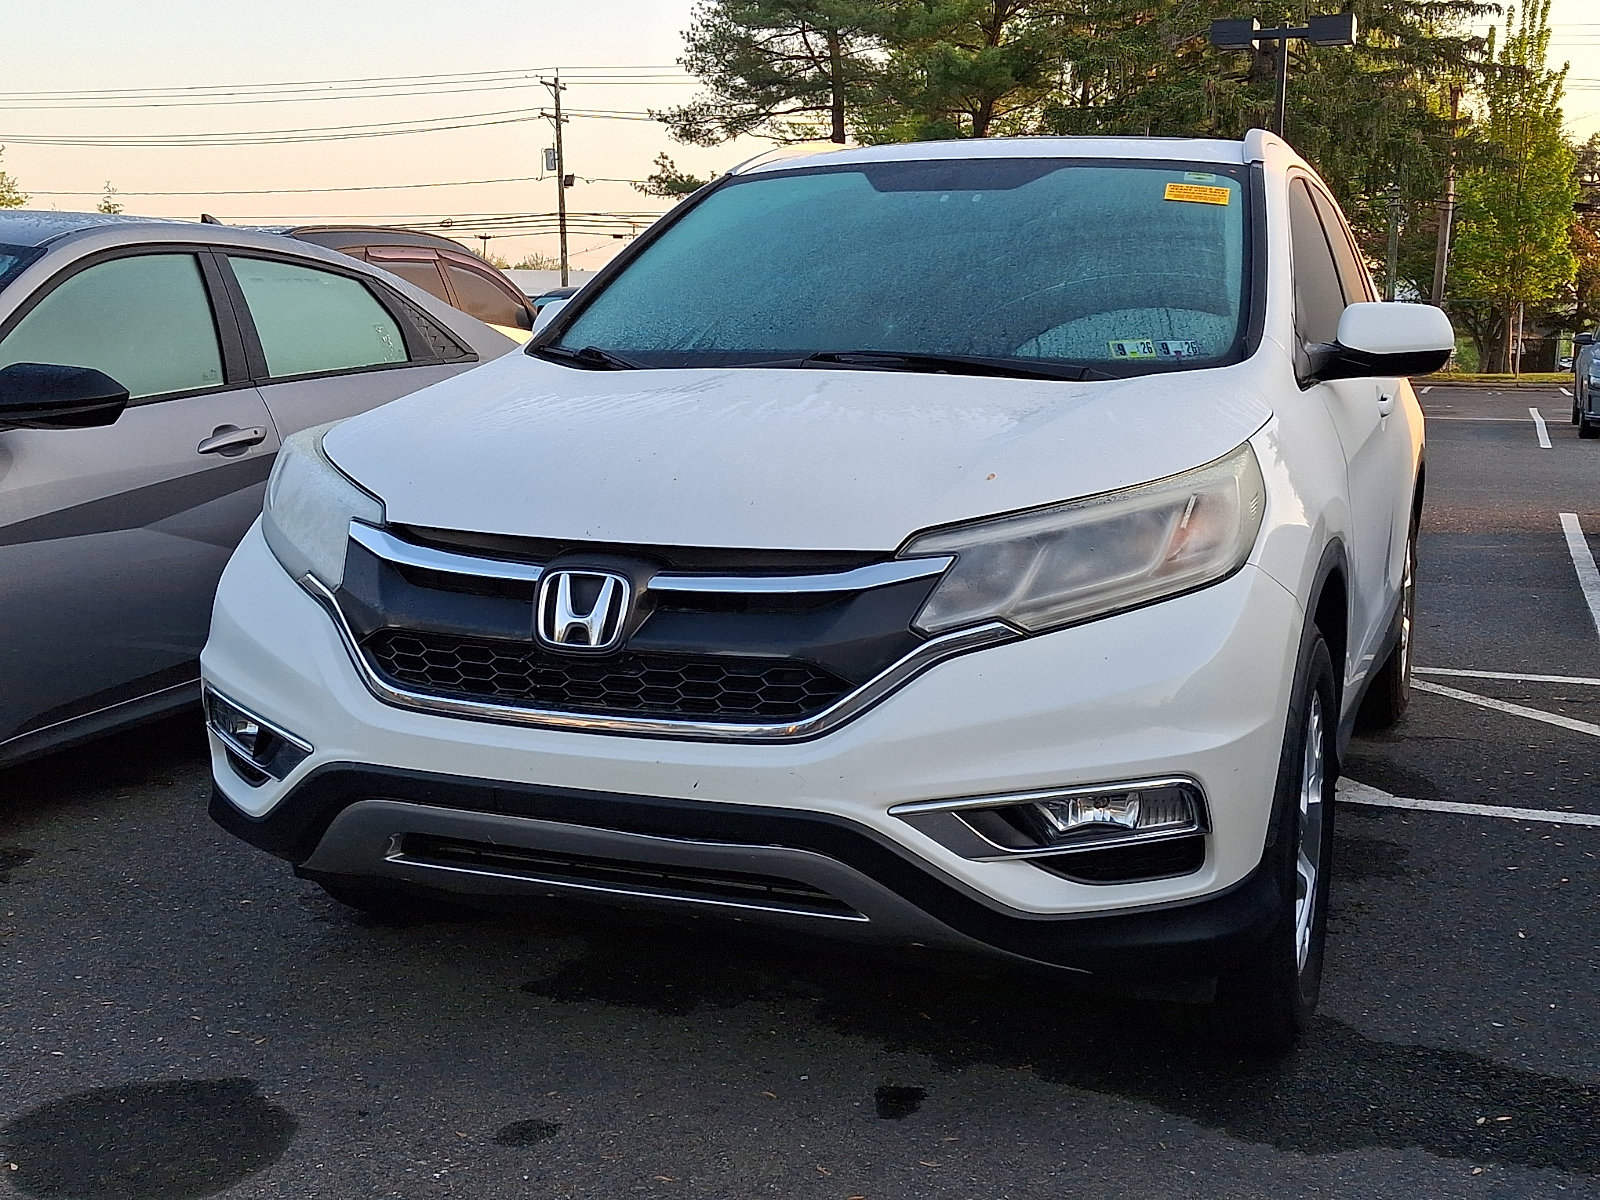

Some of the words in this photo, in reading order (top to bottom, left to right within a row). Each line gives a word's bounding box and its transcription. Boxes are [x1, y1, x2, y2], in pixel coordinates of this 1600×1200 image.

[1117, 343, 1127, 356] 9
[1140, 341, 1153, 354] 26
[1161, 342, 1170, 355] 9
[1185, 341, 1198, 354] 26
